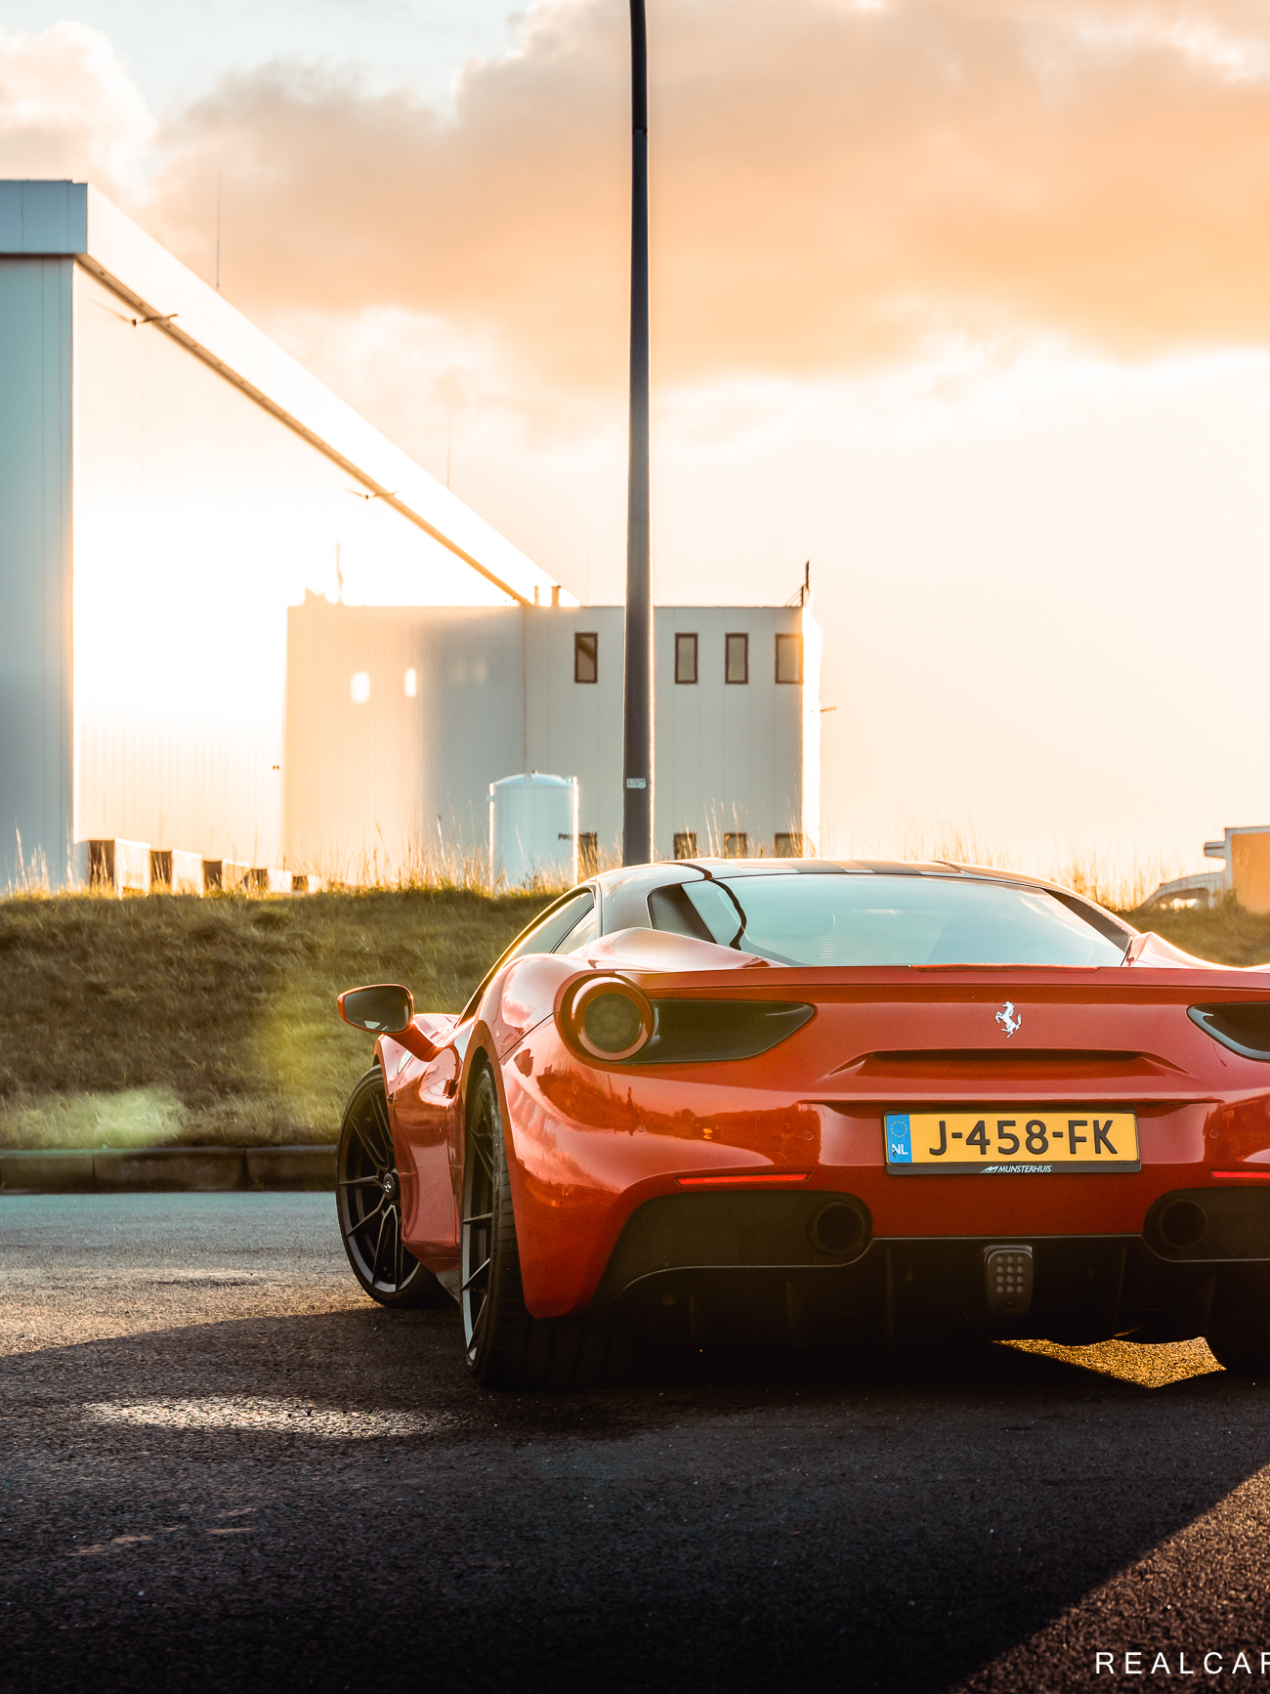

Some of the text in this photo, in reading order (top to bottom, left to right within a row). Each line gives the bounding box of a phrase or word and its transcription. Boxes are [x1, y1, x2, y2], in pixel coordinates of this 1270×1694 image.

[929, 1119, 1118, 1156] J-458-FK
[891, 1143, 909, 1155] NL
[997, 1164, 1052, 1173] MUNSTERHUIS
